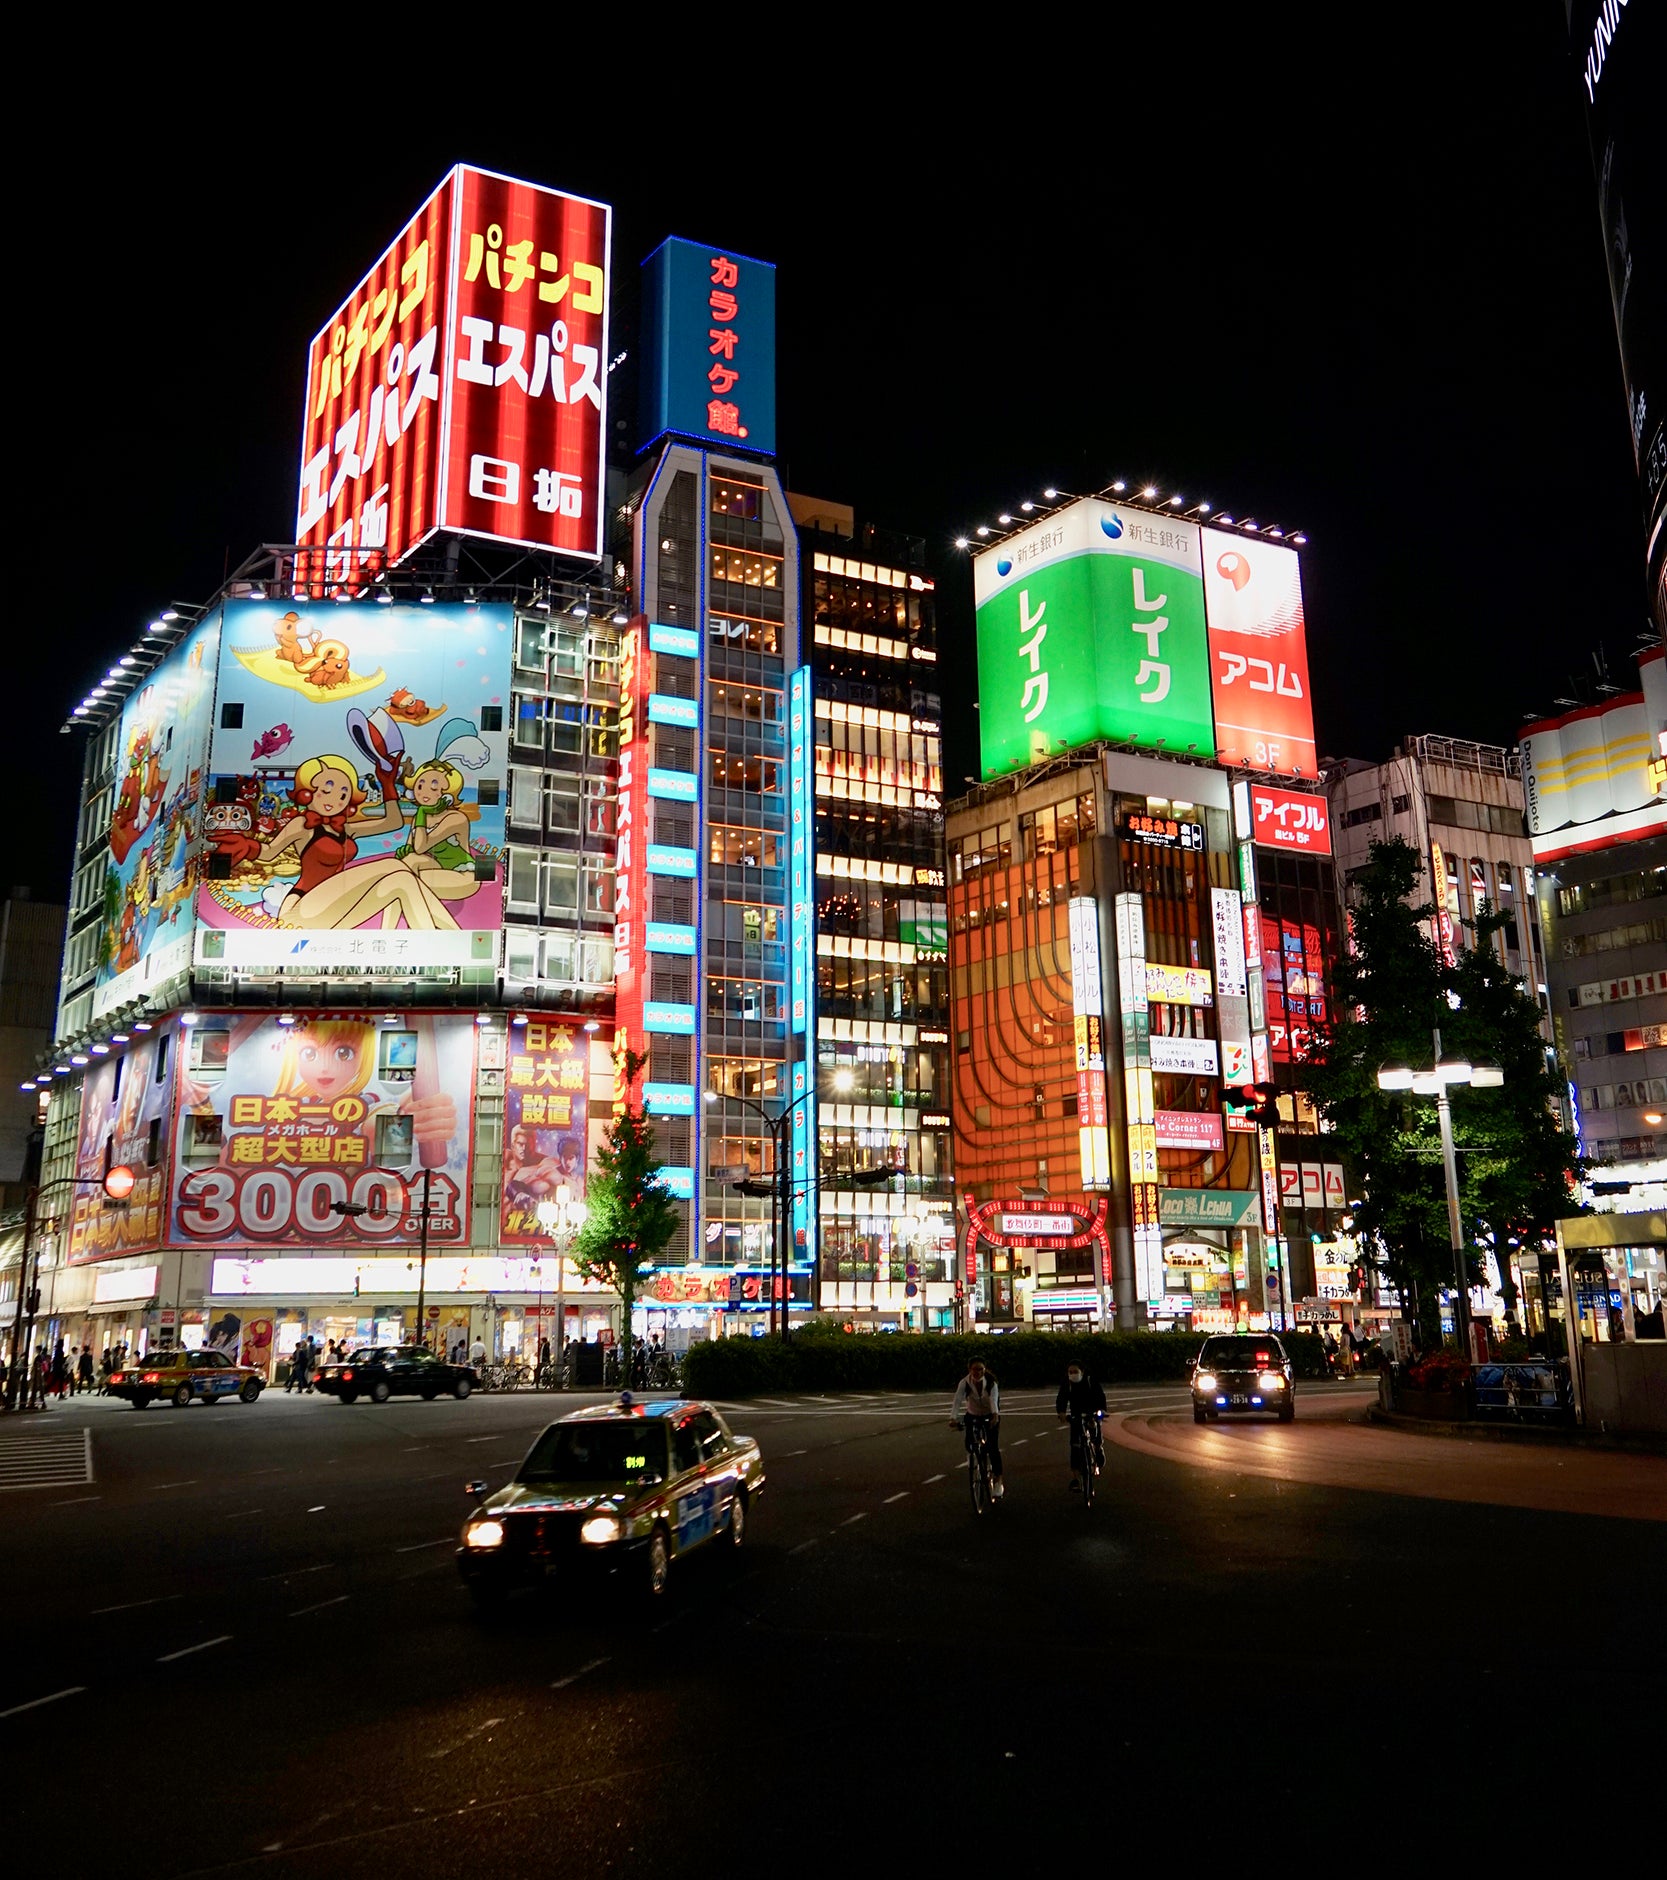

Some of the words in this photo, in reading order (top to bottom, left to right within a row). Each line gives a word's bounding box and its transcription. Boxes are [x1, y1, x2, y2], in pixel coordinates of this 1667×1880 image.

[464, 224, 603, 315] パチンコ
[316, 239, 429, 418] パチンコ
[457, 316, 601, 411] エスパス
[299, 325, 438, 540] エスパス
[1016, 526, 1065, 564] 新生銀行
[1128, 522, 1189, 553] 新生銀行
[1131, 567, 1171, 704] レイク
[1018, 589, 1049, 723] レイク
[619, 631, 636, 746] パチンコ
[1218, 650, 1304, 699] アコム
[1254, 741, 1281, 763] 3F
[1524, 740, 1532, 771] Don
[1255, 797, 1325, 831] アイフル
[1527, 775, 1540, 831] Quijote
[616, 750, 632, 913] エスパス
[349, 939, 409, 954] 北電子
[526, 1023, 574, 1054] 日本
[510, 1055, 585, 1090] 最大級
[233, 1097, 362, 1123] 日本一の
[522, 1094, 571, 1125] 設置
[267, 1124, 338, 1136] メガホール
[1168, 1122, 1198, 1133] Corner
[1200, 1124, 1213, 1133] 117
[1212, 1139, 1221, 1148] 4F
[232, 1136, 365, 1164] 超大型店
[1281, 1169, 1343, 1194] アコム
[179, 1170, 454, 1234] 3000台
[1246, 1212, 1258, 1222] 3F
[1303, 1310, 1339, 1320] チカラめし
